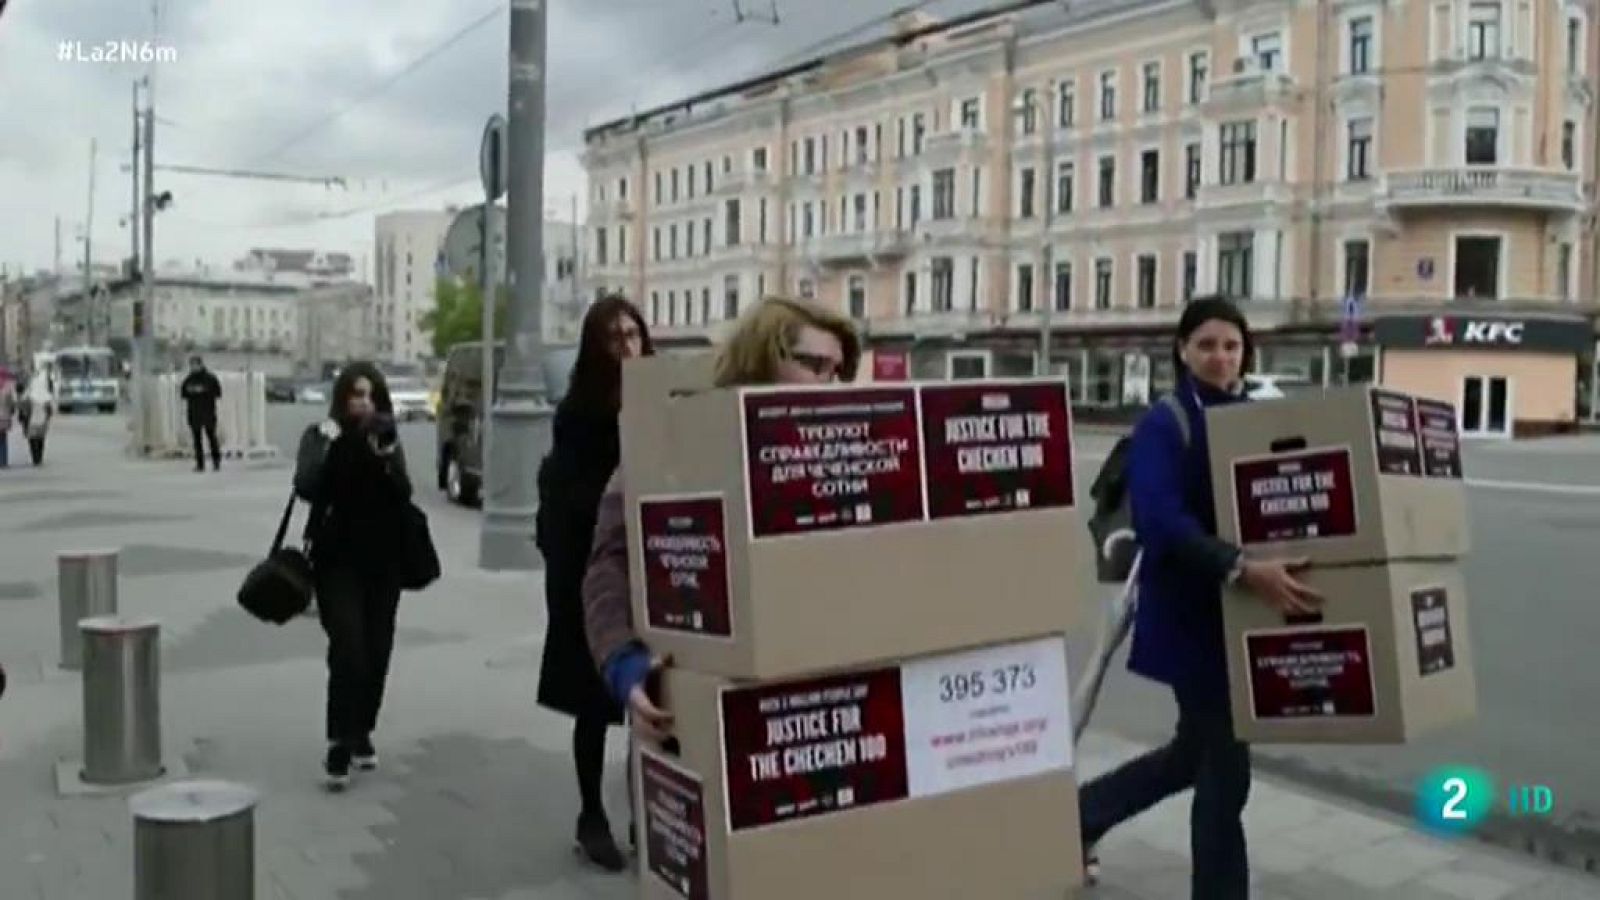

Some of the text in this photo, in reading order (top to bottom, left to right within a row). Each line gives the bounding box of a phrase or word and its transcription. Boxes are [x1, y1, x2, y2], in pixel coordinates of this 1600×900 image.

[1464, 320, 1524, 343] KFC
[798, 422, 869, 441] ТРЕБУЮТ
[945, 412, 1050, 444] JUSTICE FOR THE
[759, 438, 908, 462] СПРАВЕДЛИВОСТИ
[957, 443, 1043, 474] CHECHEN 100
[772, 455, 900, 484] ДЛЯ ЧЕЧЕНСКОЙ
[811, 478, 868, 497] СОТНИ
[1251, 472, 1335, 498] JUSTICE FOR THE
[1260, 493, 1329, 515] CHECHEN 100
[939, 664, 1036, 702] 395 373
[766, 704, 861, 746] JUSTICE FOR
[750, 733, 887, 781] THE CHECHEN 100
